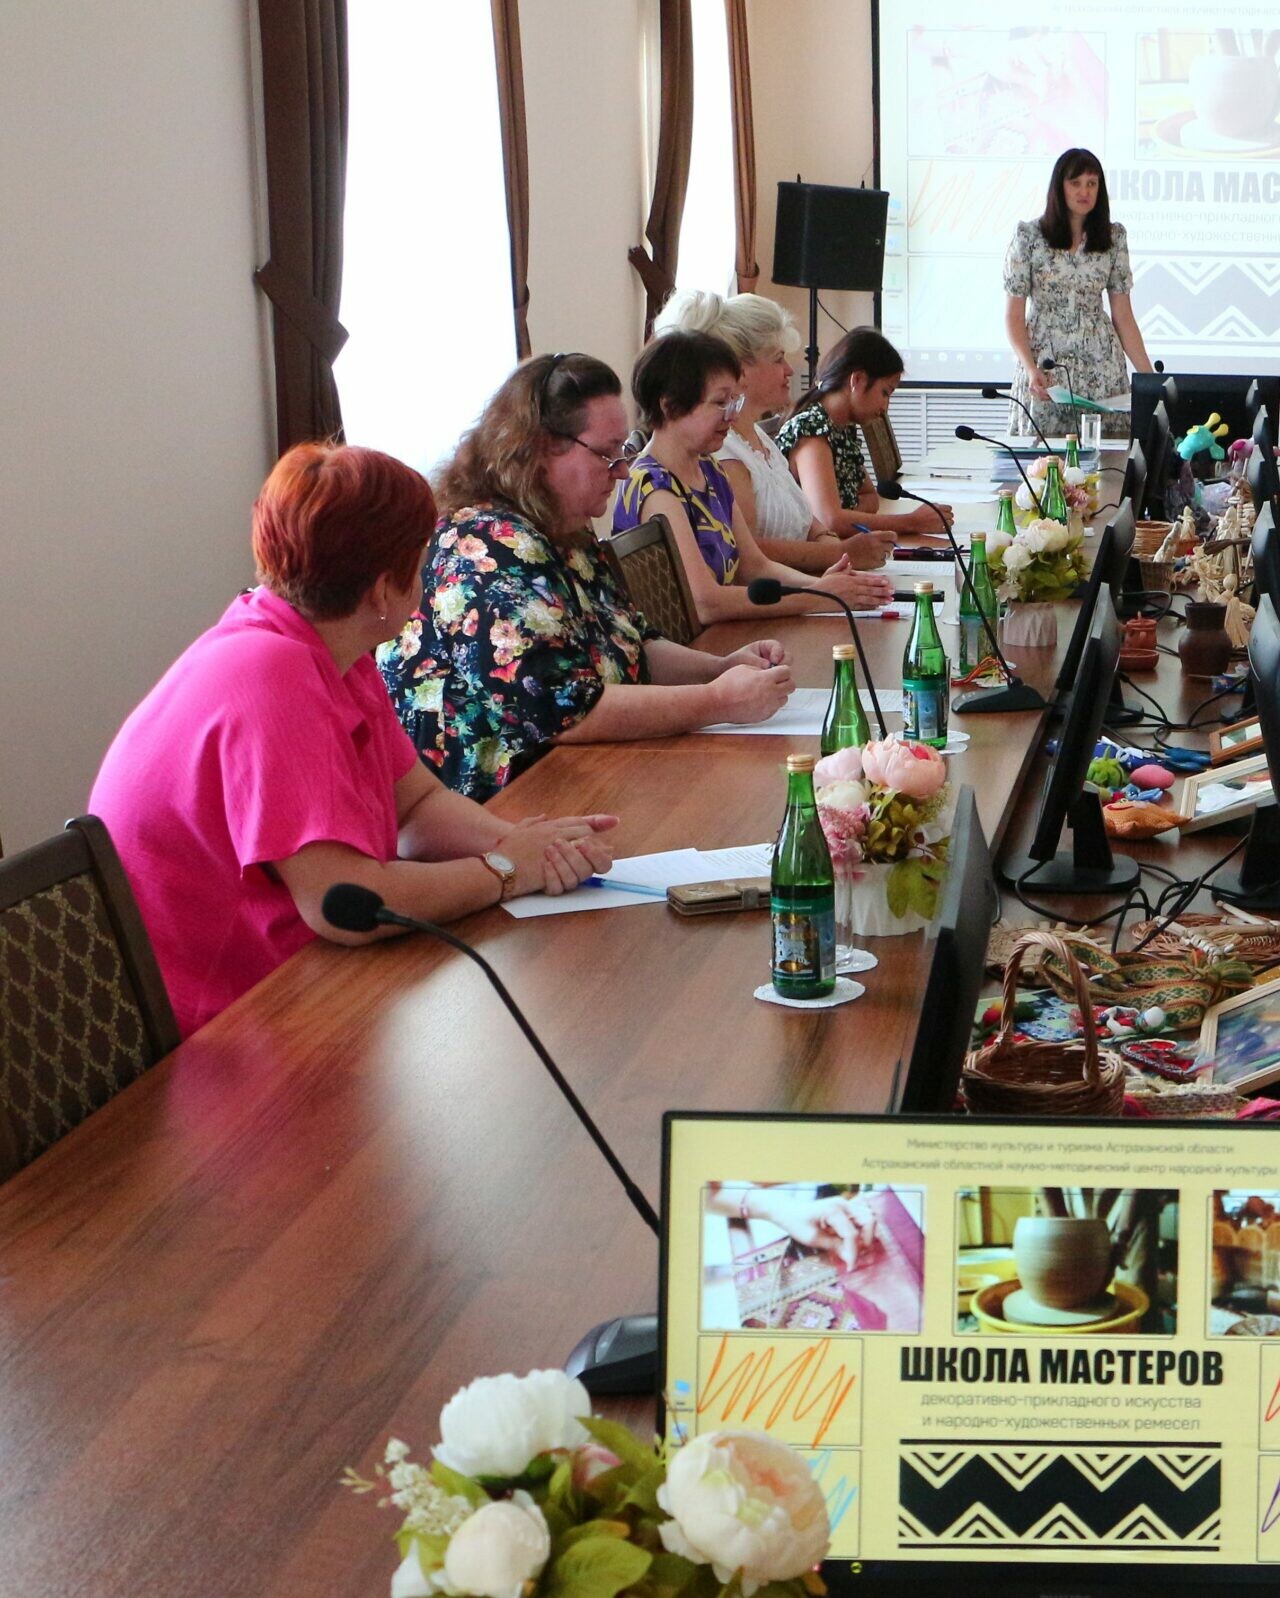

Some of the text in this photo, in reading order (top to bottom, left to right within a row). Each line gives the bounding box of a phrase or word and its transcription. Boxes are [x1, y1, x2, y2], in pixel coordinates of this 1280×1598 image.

[906, 1138, 988, 1151] Министерство
[991, 1142, 1044, 1154] культуры
[1057, 1143, 1103, 1154] туризма
[1106, 1142, 1185, 1155] Астраханской
[1189, 1143, 1235, 1154] области
[861, 1158, 1278, 1177] Астраханский областной научно-методический центр народной культуры
[900, 1346, 1225, 1387] ШКОЛА МАСТЕРОВ
[920, 1392, 1203, 1411] декоративно-прикладного искусства
[922, 1415, 1201, 1433] и народно-художественных ремесел
